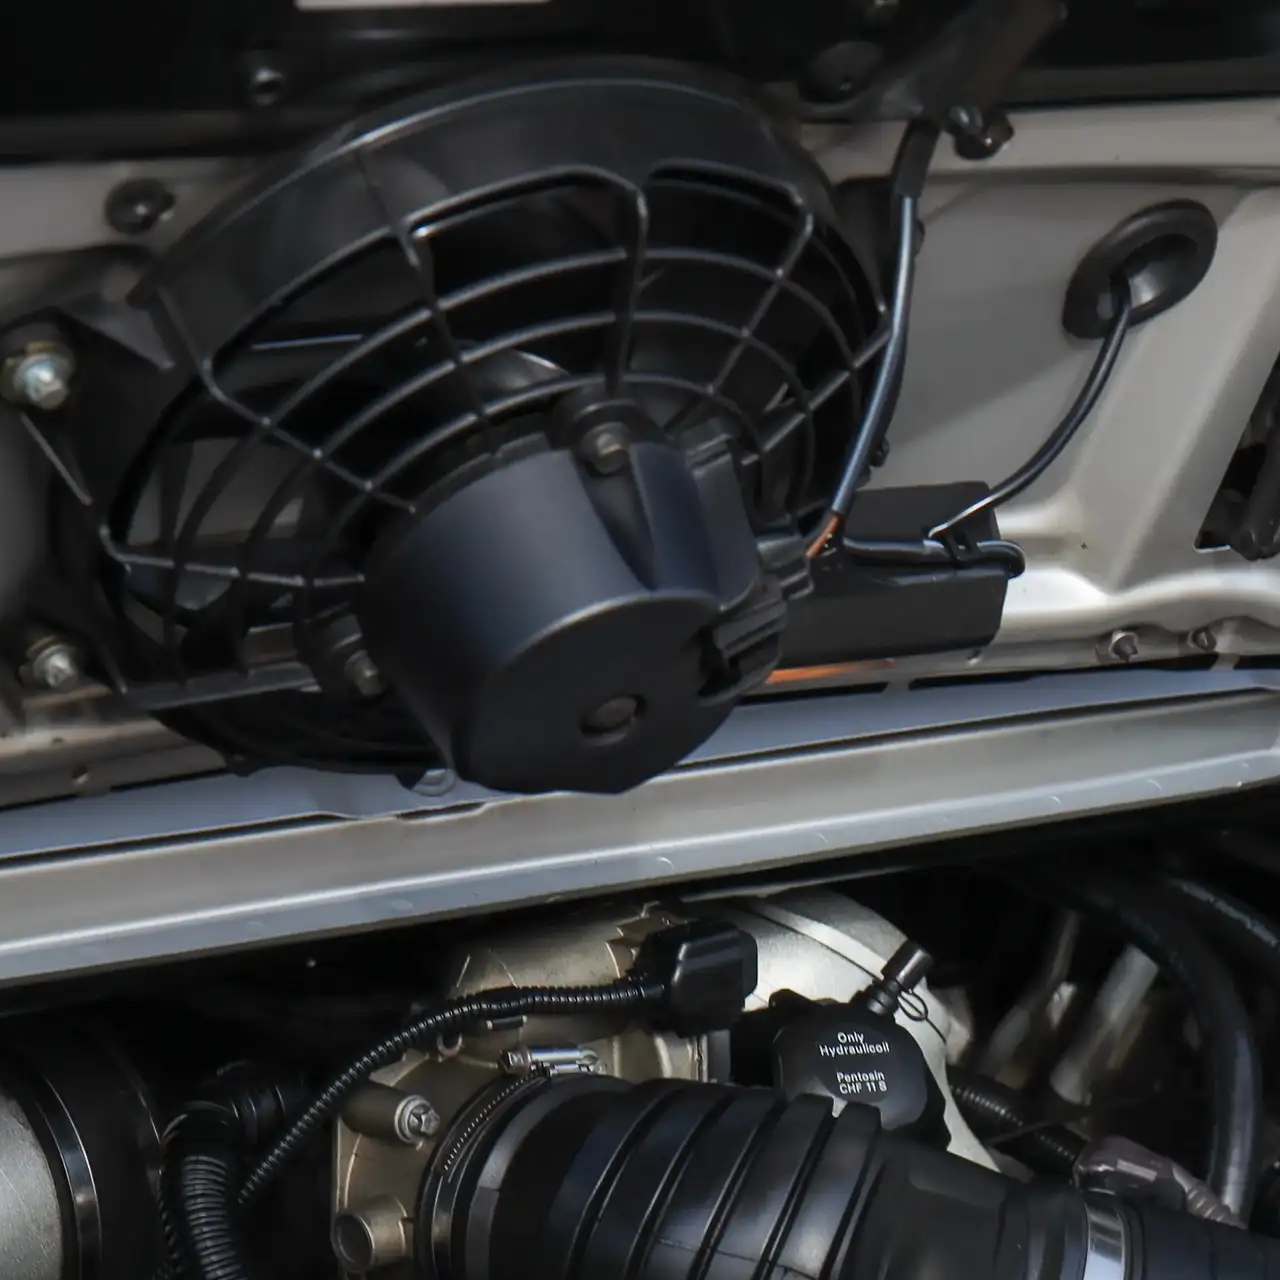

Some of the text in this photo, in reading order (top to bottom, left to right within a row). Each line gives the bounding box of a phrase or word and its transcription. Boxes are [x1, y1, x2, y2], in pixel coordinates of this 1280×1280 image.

[837, 1031, 864, 1044] Only
[819, 1041, 890, 1058] Hydraulicoil
[836, 1070, 885, 1083] Pentosin
[839, 1082, 862, 1095] CHF
[866, 1081, 877, 1093] 11
